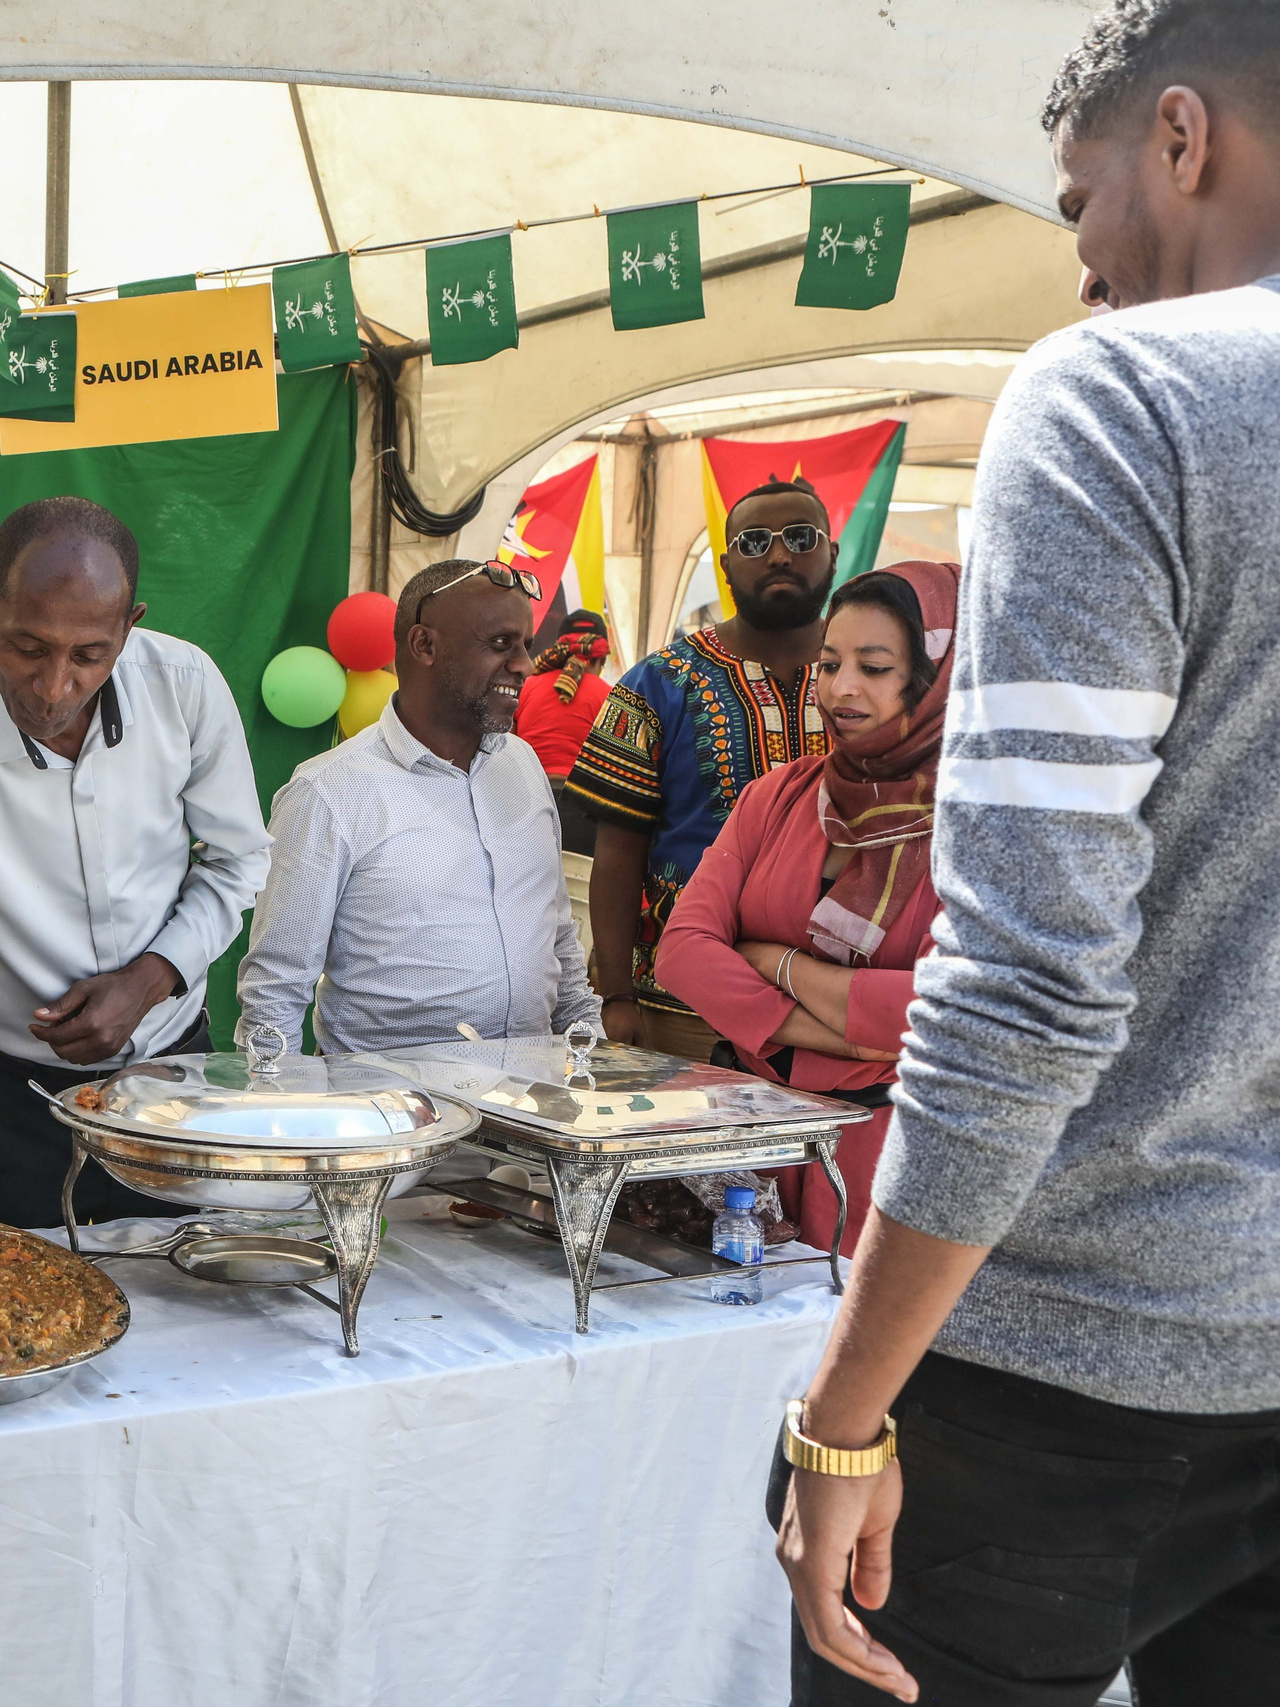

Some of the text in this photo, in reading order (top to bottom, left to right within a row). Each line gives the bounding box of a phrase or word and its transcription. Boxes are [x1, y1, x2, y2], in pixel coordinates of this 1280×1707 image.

[869, 238, 881, 251] في
[667, 253, 680, 265] في
[670, 268, 680, 290] الوطن
[486, 291, 498, 302] في
[324, 302, 336, 312] في
[488, 305, 498, 326] الوطن
[327, 315, 338, 336] الوطن
[48, 360, 59, 370] في
[82, 349, 263, 385] SAUDI ARABIA
[49, 372, 57, 392] الوطن
